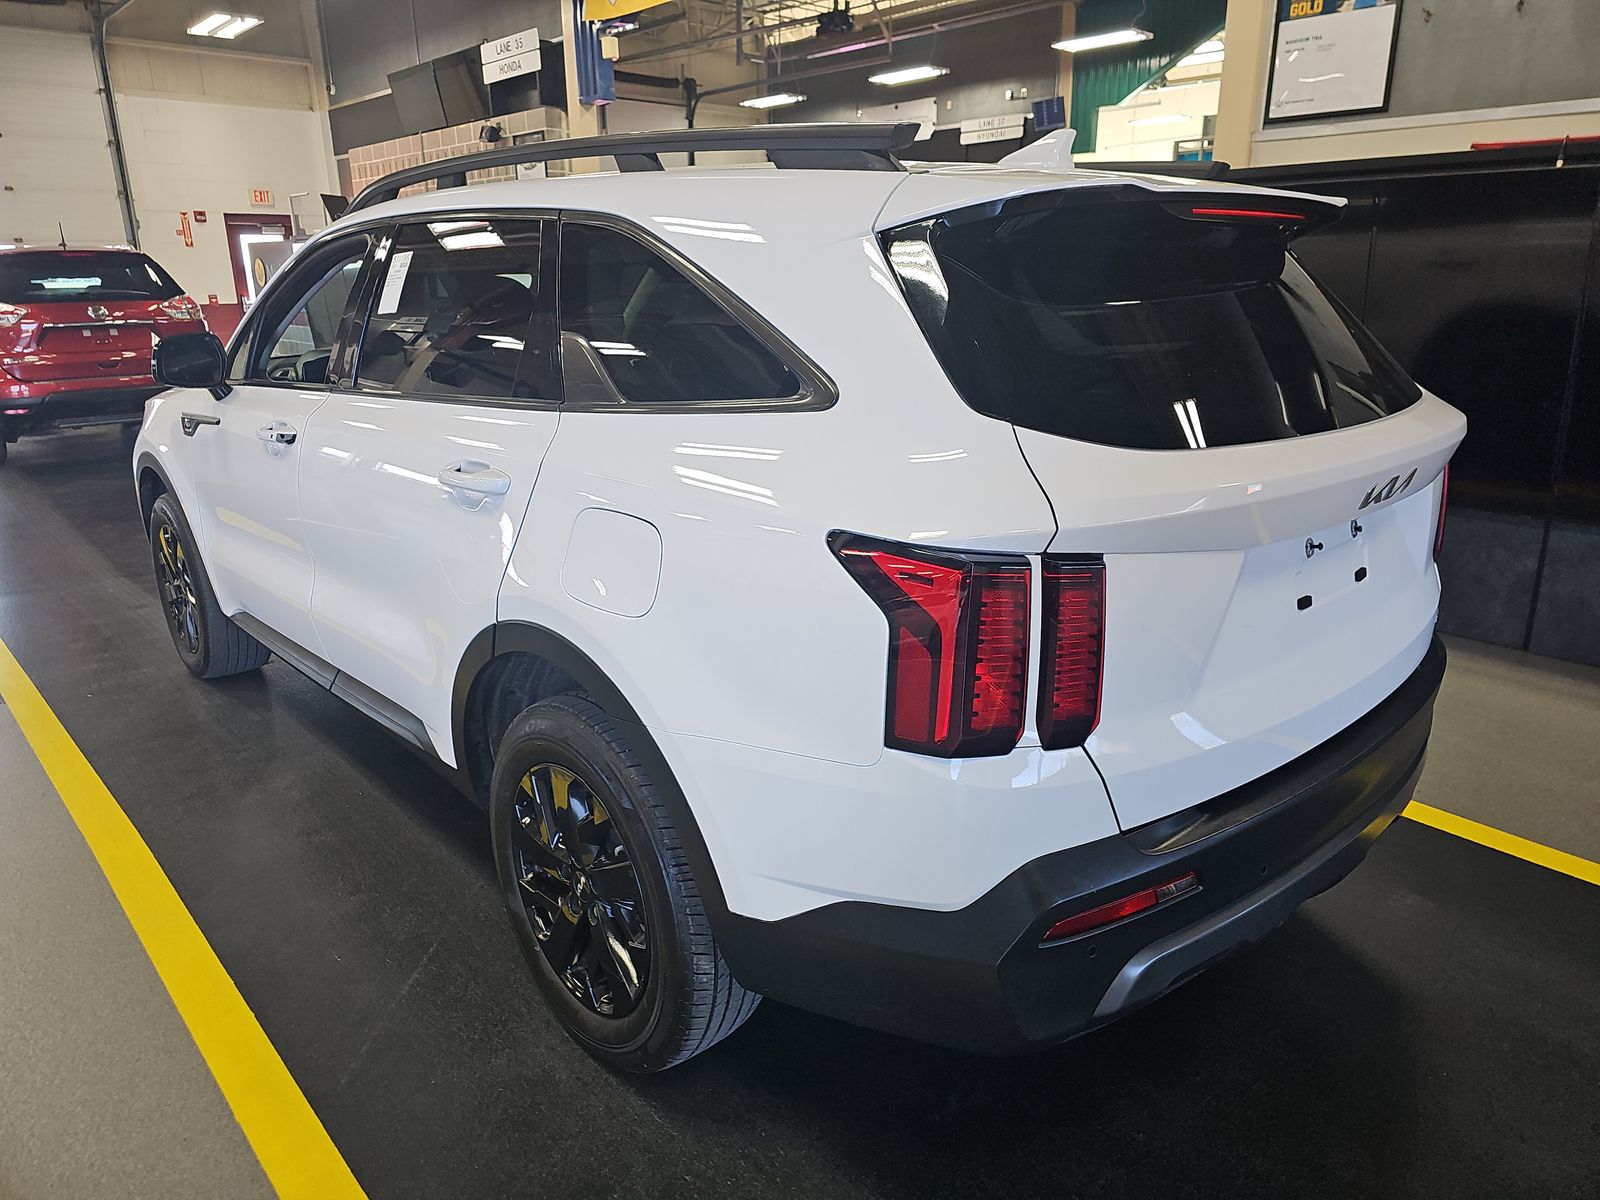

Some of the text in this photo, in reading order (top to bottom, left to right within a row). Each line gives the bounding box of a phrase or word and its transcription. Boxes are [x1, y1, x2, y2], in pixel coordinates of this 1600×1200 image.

[1290, 0, 1323, 17] GOLD
[495, 37, 523, 55] LANE 35
[499, 60, 522, 75] HONDA
[977, 119, 995, 129] LANE
[976, 129, 1006, 140] HYUNDAI
[253, 190, 270, 203] EXIT
[1358, 467, 1418, 510] KIA
